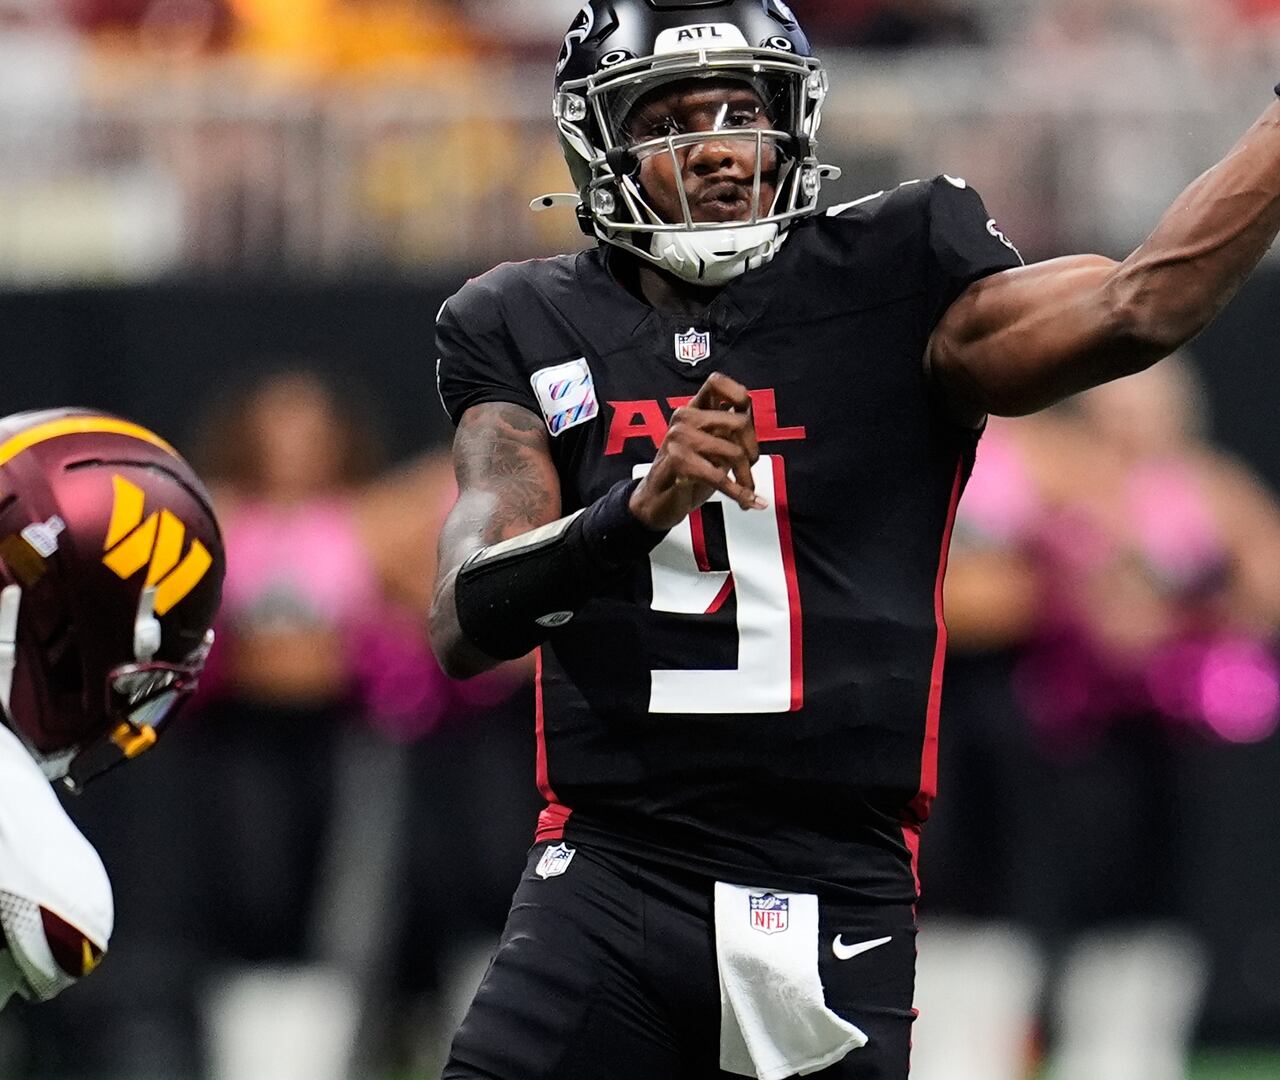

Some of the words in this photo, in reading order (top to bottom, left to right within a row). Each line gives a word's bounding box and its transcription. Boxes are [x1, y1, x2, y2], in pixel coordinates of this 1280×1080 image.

[677, 26, 722, 42] ATL
[632, 454, 803, 714] 9
[755, 911, 784, 929] NFL
